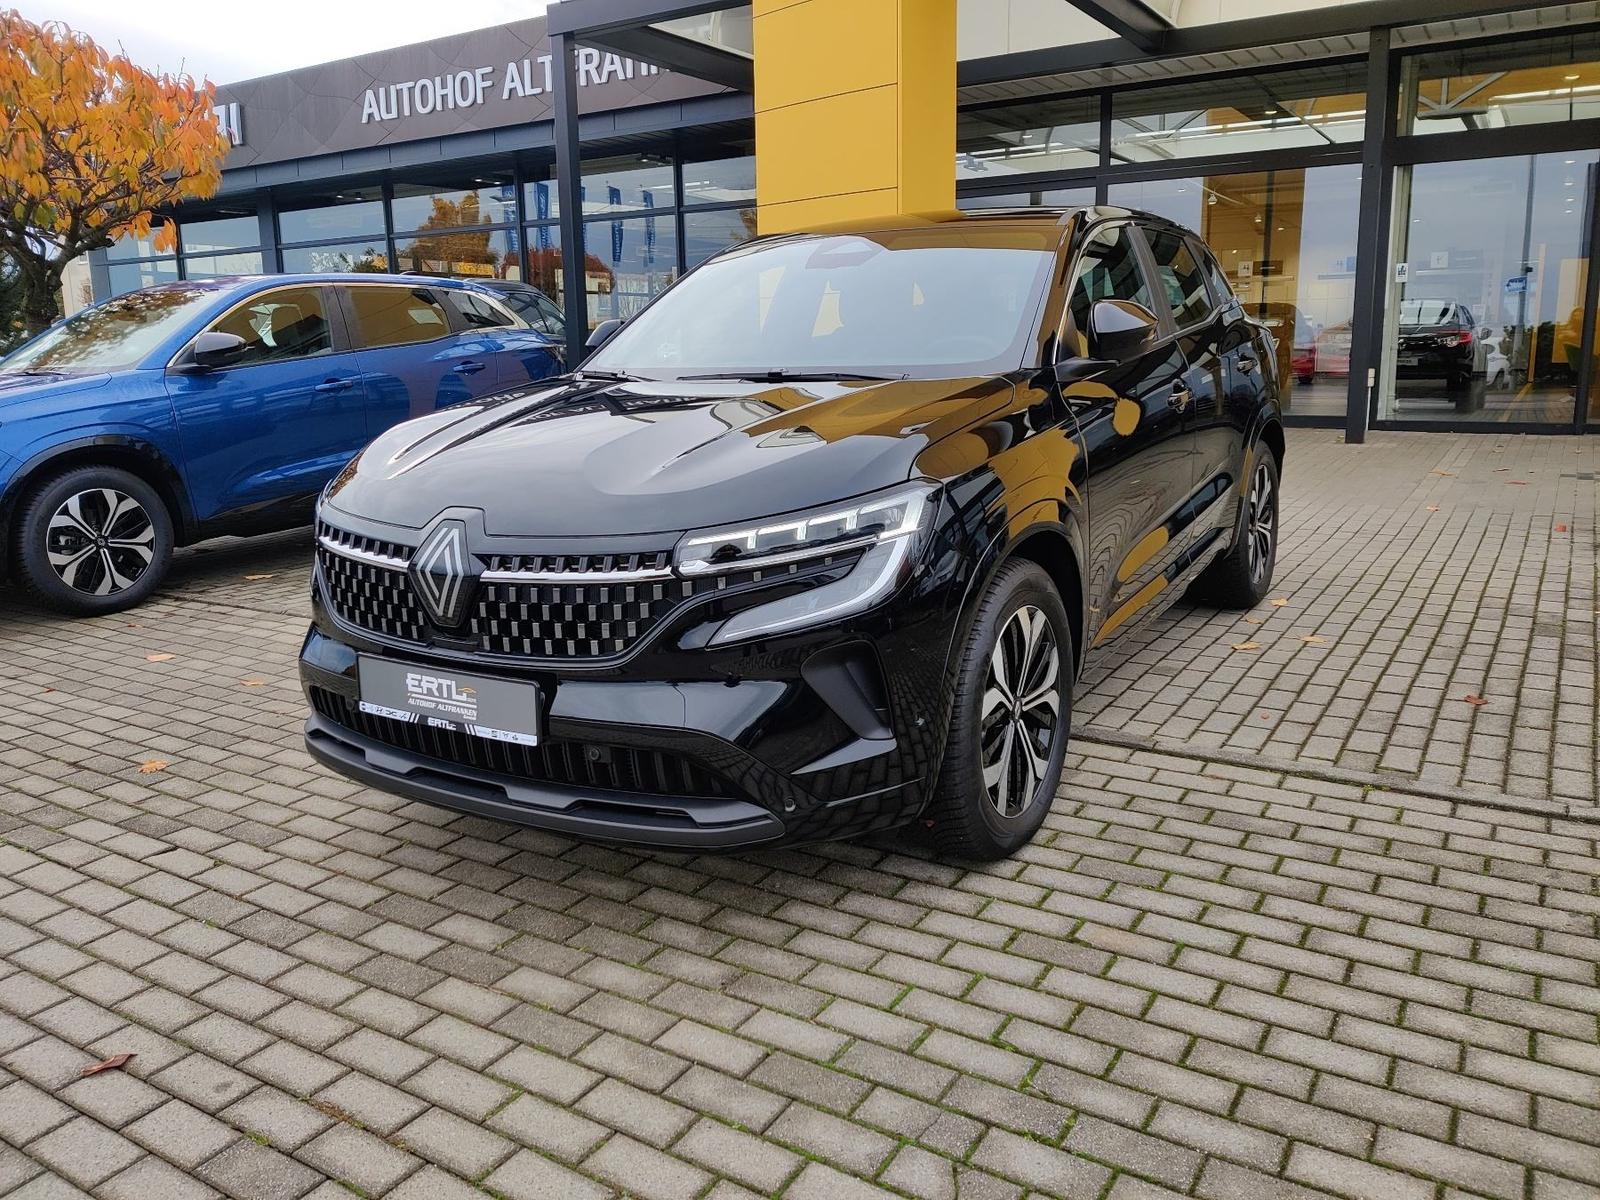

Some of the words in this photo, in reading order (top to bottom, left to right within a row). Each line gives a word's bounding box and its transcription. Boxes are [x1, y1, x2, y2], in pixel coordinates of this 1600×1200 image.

[361, 66, 494, 124] AUTOHOF
[406, 672, 467, 701] ERTL
[427, 717, 454, 730] ERTL
